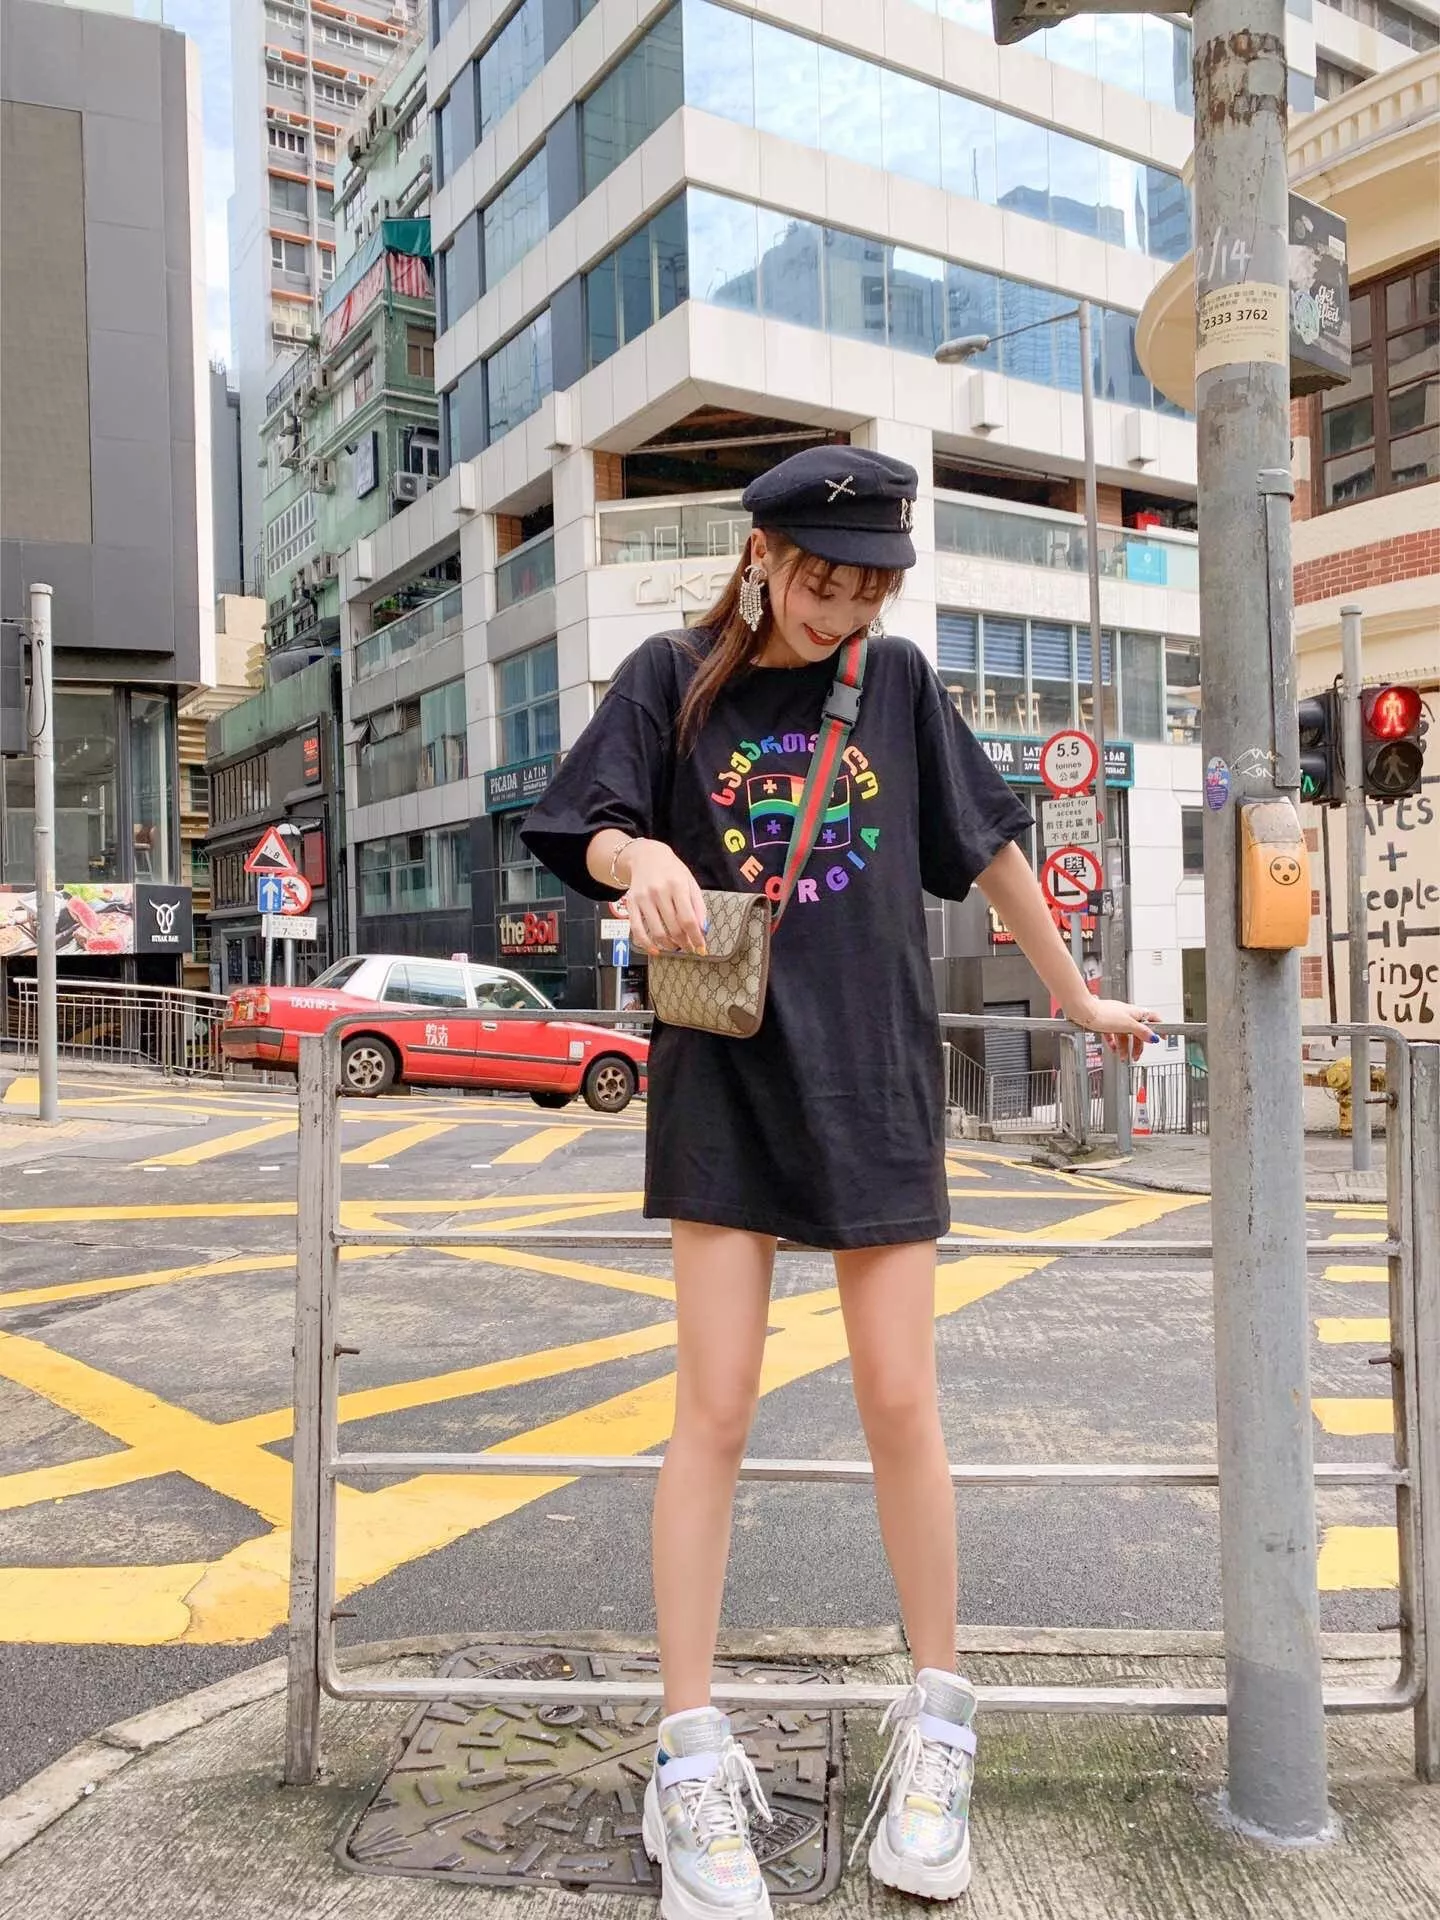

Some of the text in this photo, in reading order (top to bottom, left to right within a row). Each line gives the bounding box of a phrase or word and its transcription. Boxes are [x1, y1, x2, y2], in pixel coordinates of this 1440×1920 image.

[1203, 310, 1268, 330] 2333 3762
[1057, 742, 1080, 757] 5.5
[711, 733, 879, 807] საქართლო
[1055, 762, 1082, 770] tonnes
[490, 773, 518, 794] PICADA
[523, 765, 547, 780] LATIN
[1049, 800, 1074, 809] Except
[723, 828, 881, 904] GEORGIA
[1054, 870, 1080, 896] L
[1366, 878, 1440, 917] eople
[1080, 931, 1093, 939] AR
[1367, 957, 1439, 999] ringe
[1377, 990, 1434, 1024] lub
[425, 1024, 448, 1035] 的士
[425, 1034, 448, 1046] TAXI
